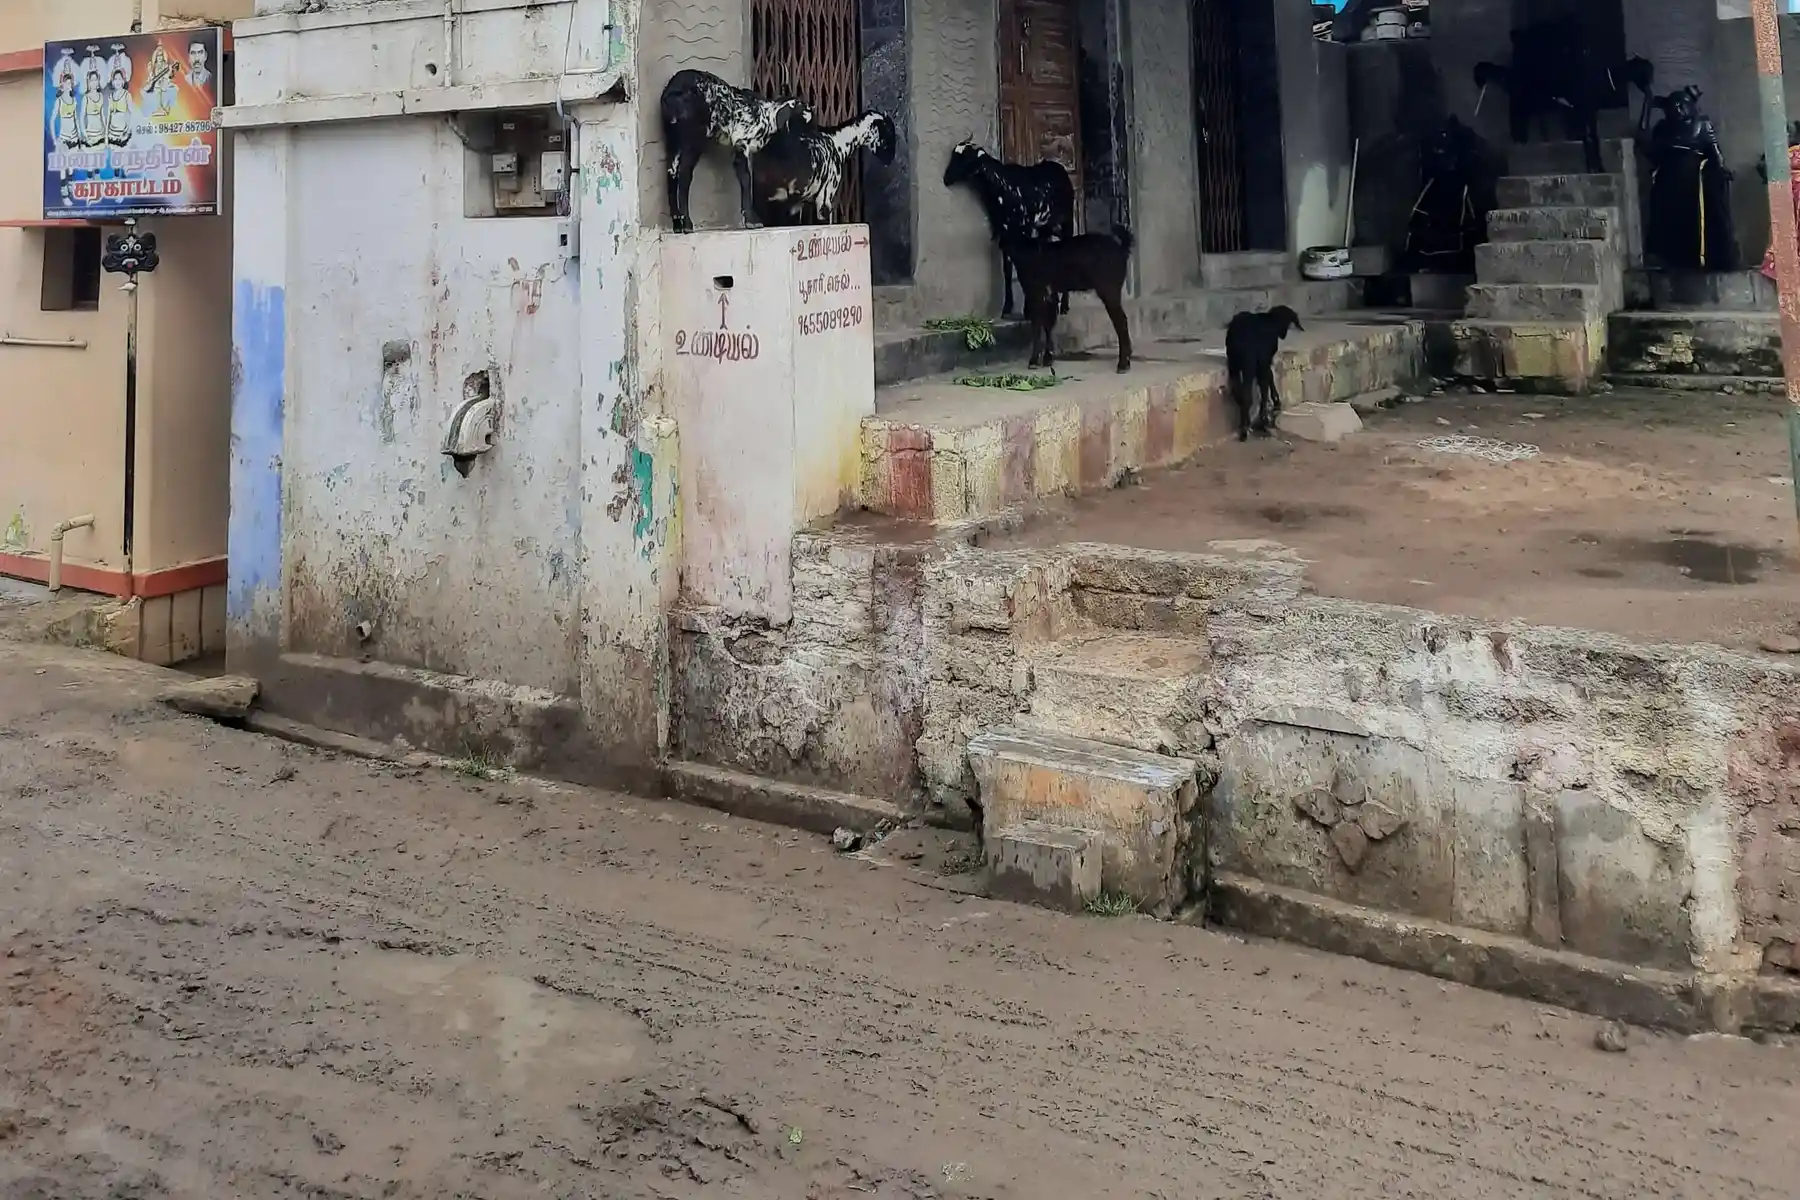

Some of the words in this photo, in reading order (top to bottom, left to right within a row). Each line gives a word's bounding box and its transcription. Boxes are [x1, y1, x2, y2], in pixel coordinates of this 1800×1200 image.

[73, 171, 182, 204] கரகாட்டம்
[797, 229, 852, 261] உண்டியல்
[797, 305, 863, 337] 9655089290
[675, 325, 760, 364] உண்டியல்
